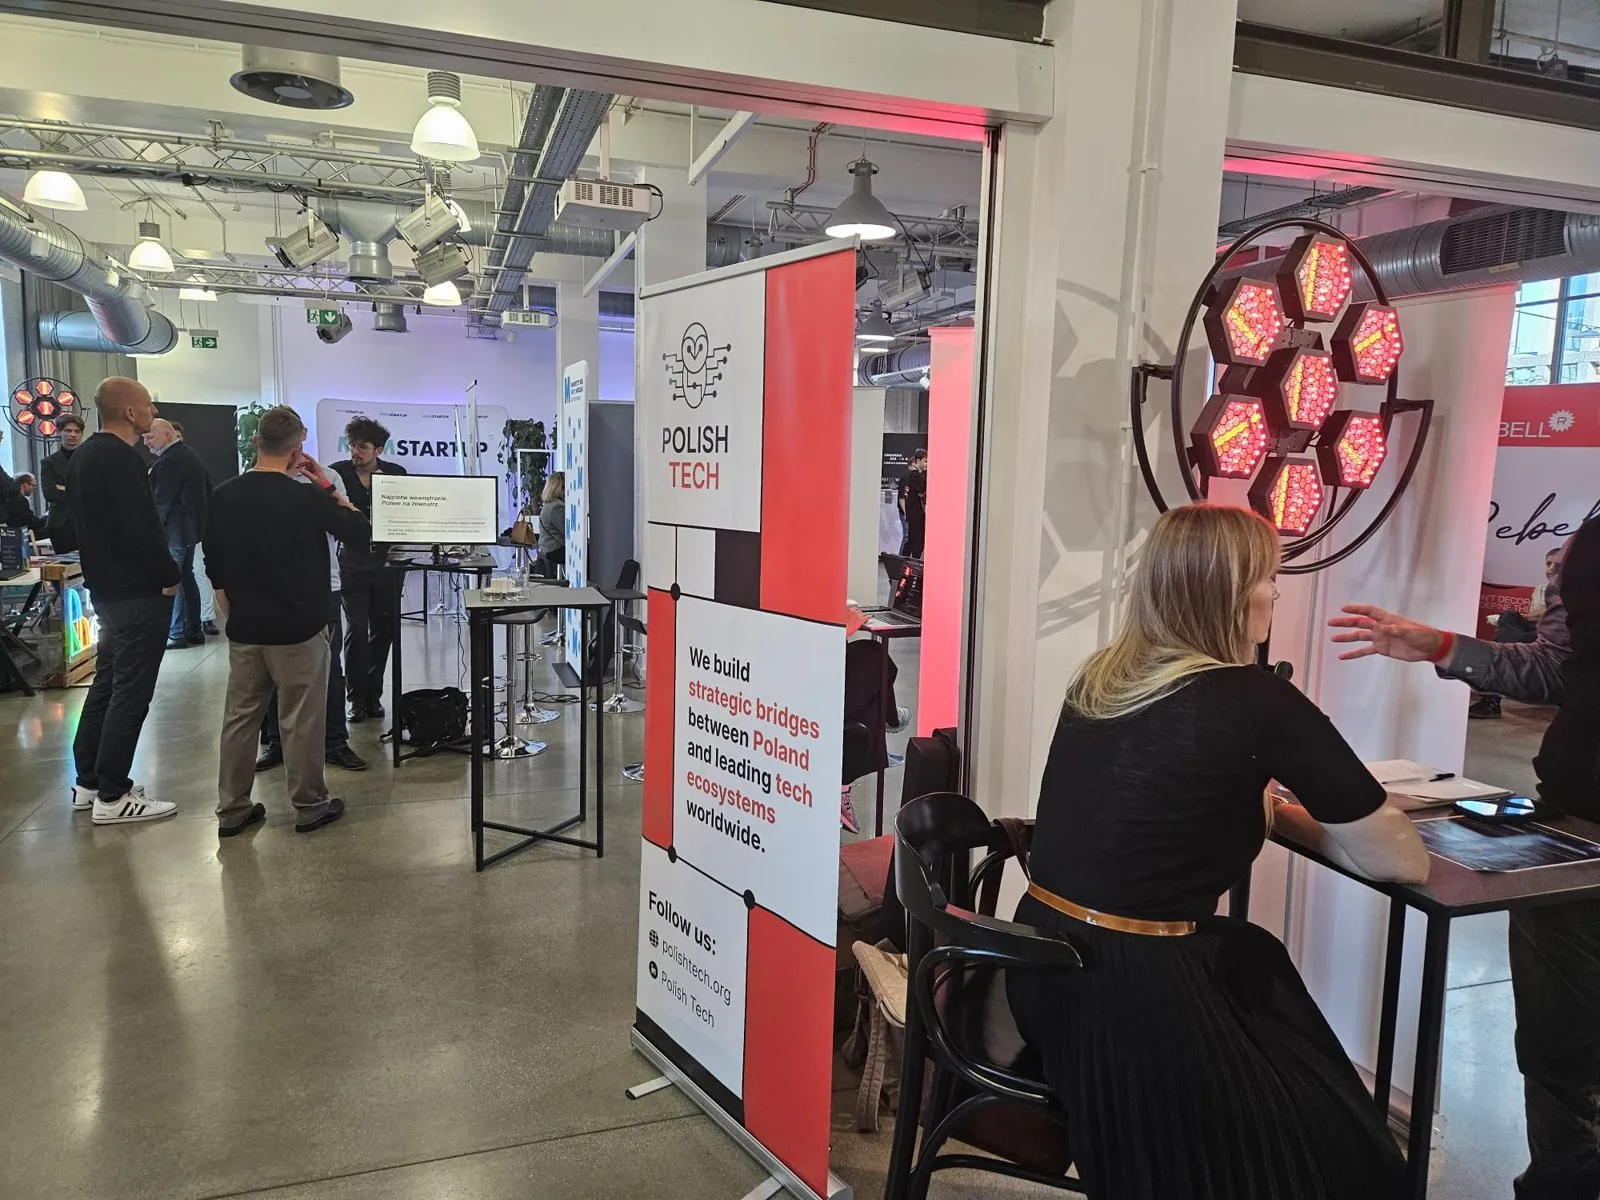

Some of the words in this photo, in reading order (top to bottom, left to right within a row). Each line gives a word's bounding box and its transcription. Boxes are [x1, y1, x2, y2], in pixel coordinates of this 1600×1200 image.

[662, 425, 729, 454] POLISH
[669, 462, 720, 490] TECH
[689, 646, 711, 671] We
[713, 653, 750, 682] build
[688, 680, 752, 717] strategic
[756, 698, 820, 739] bridges
[688, 706, 749, 748] between
[753, 730, 810, 771] Poland
[687, 740, 712, 764] and
[715, 748, 771, 794] leading
[775, 773, 813, 808] tech
[687, 771, 776, 824] ecosystems
[686, 800, 765, 853] worldwide.
[648, 890, 692, 937] Follow
[694, 926, 716, 956] us:
[661, 970, 688, 1006] Polish
[690, 994, 715, 1028] Tech
[662, 939, 731, 1006] polishtech.org
